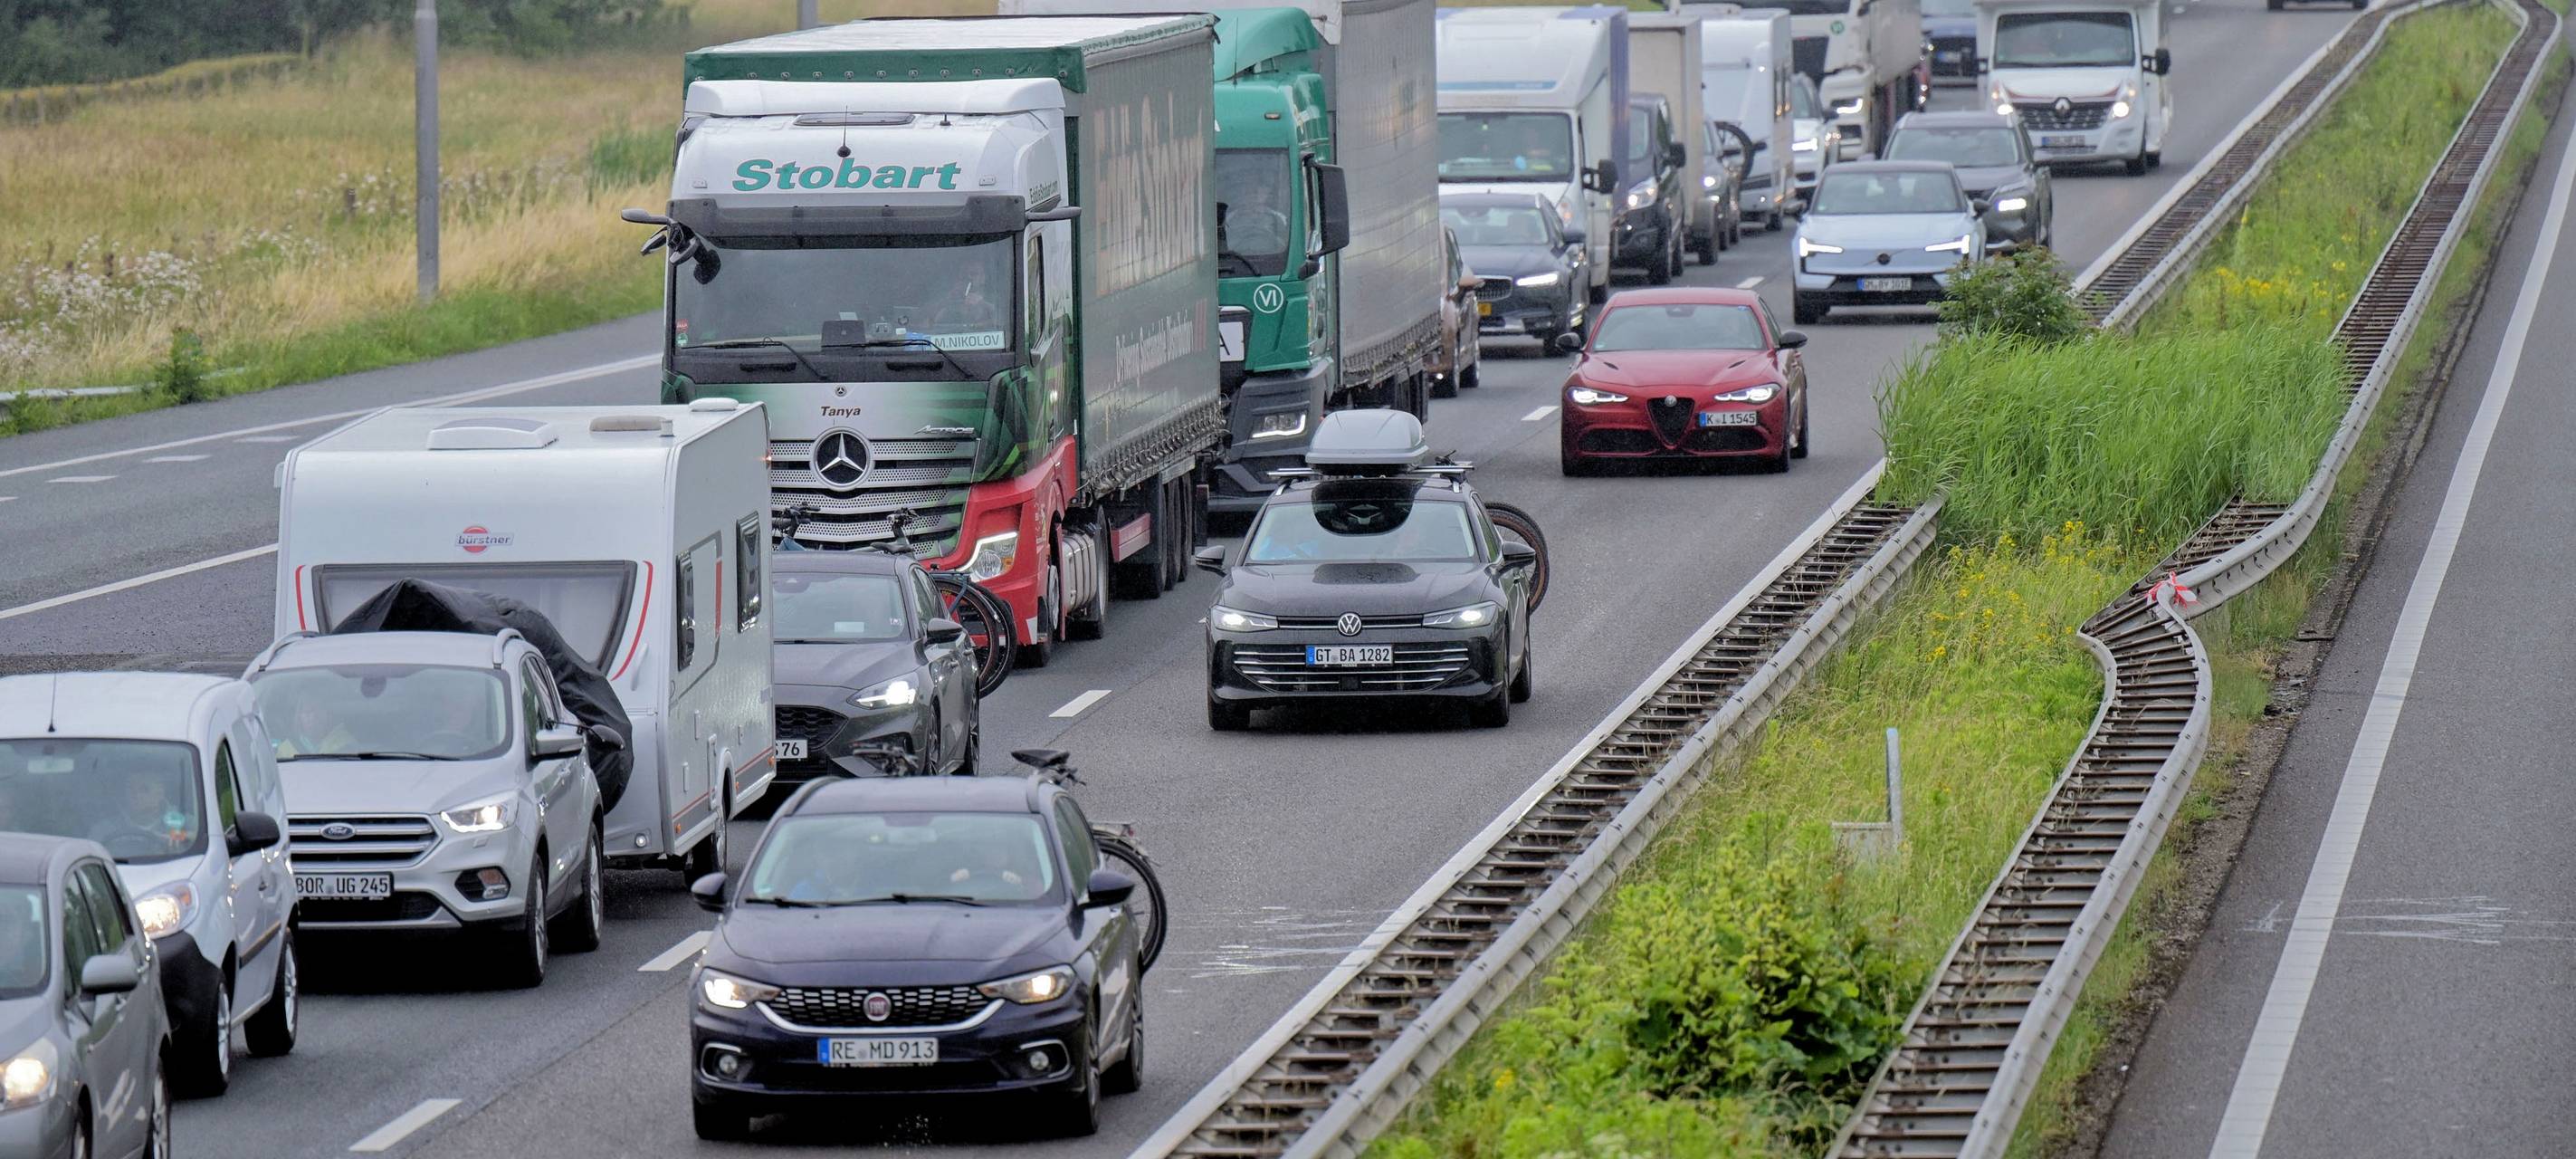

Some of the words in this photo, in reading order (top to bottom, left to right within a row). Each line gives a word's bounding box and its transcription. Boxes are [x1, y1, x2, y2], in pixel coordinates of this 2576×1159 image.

[732, 158, 962, 192] Stobart
[1141, 91, 1205, 276] Stobart
[1258, 289, 1278, 307] VI
[934, 334, 999, 349] M.NIKOLOV
[820, 406, 861, 418] Tanya
[1706, 414, 1713, 425] K
[1730, 413, 1756, 425] 1545
[458, 535, 510, 544] bürstner
[1316, 648, 1331, 662] GT
[1340, 648, 1356, 662] BA
[1360, 648, 1389, 662] 1282
[781, 742, 800, 757] 76
[295, 876, 324, 894] BOR
[336, 877, 356, 894] UG
[360, 877, 388, 894] 245
[832, 1041, 856, 1059] RE
[870, 1041, 894, 1059] MD
[899, 1041, 935, 1059] 913
